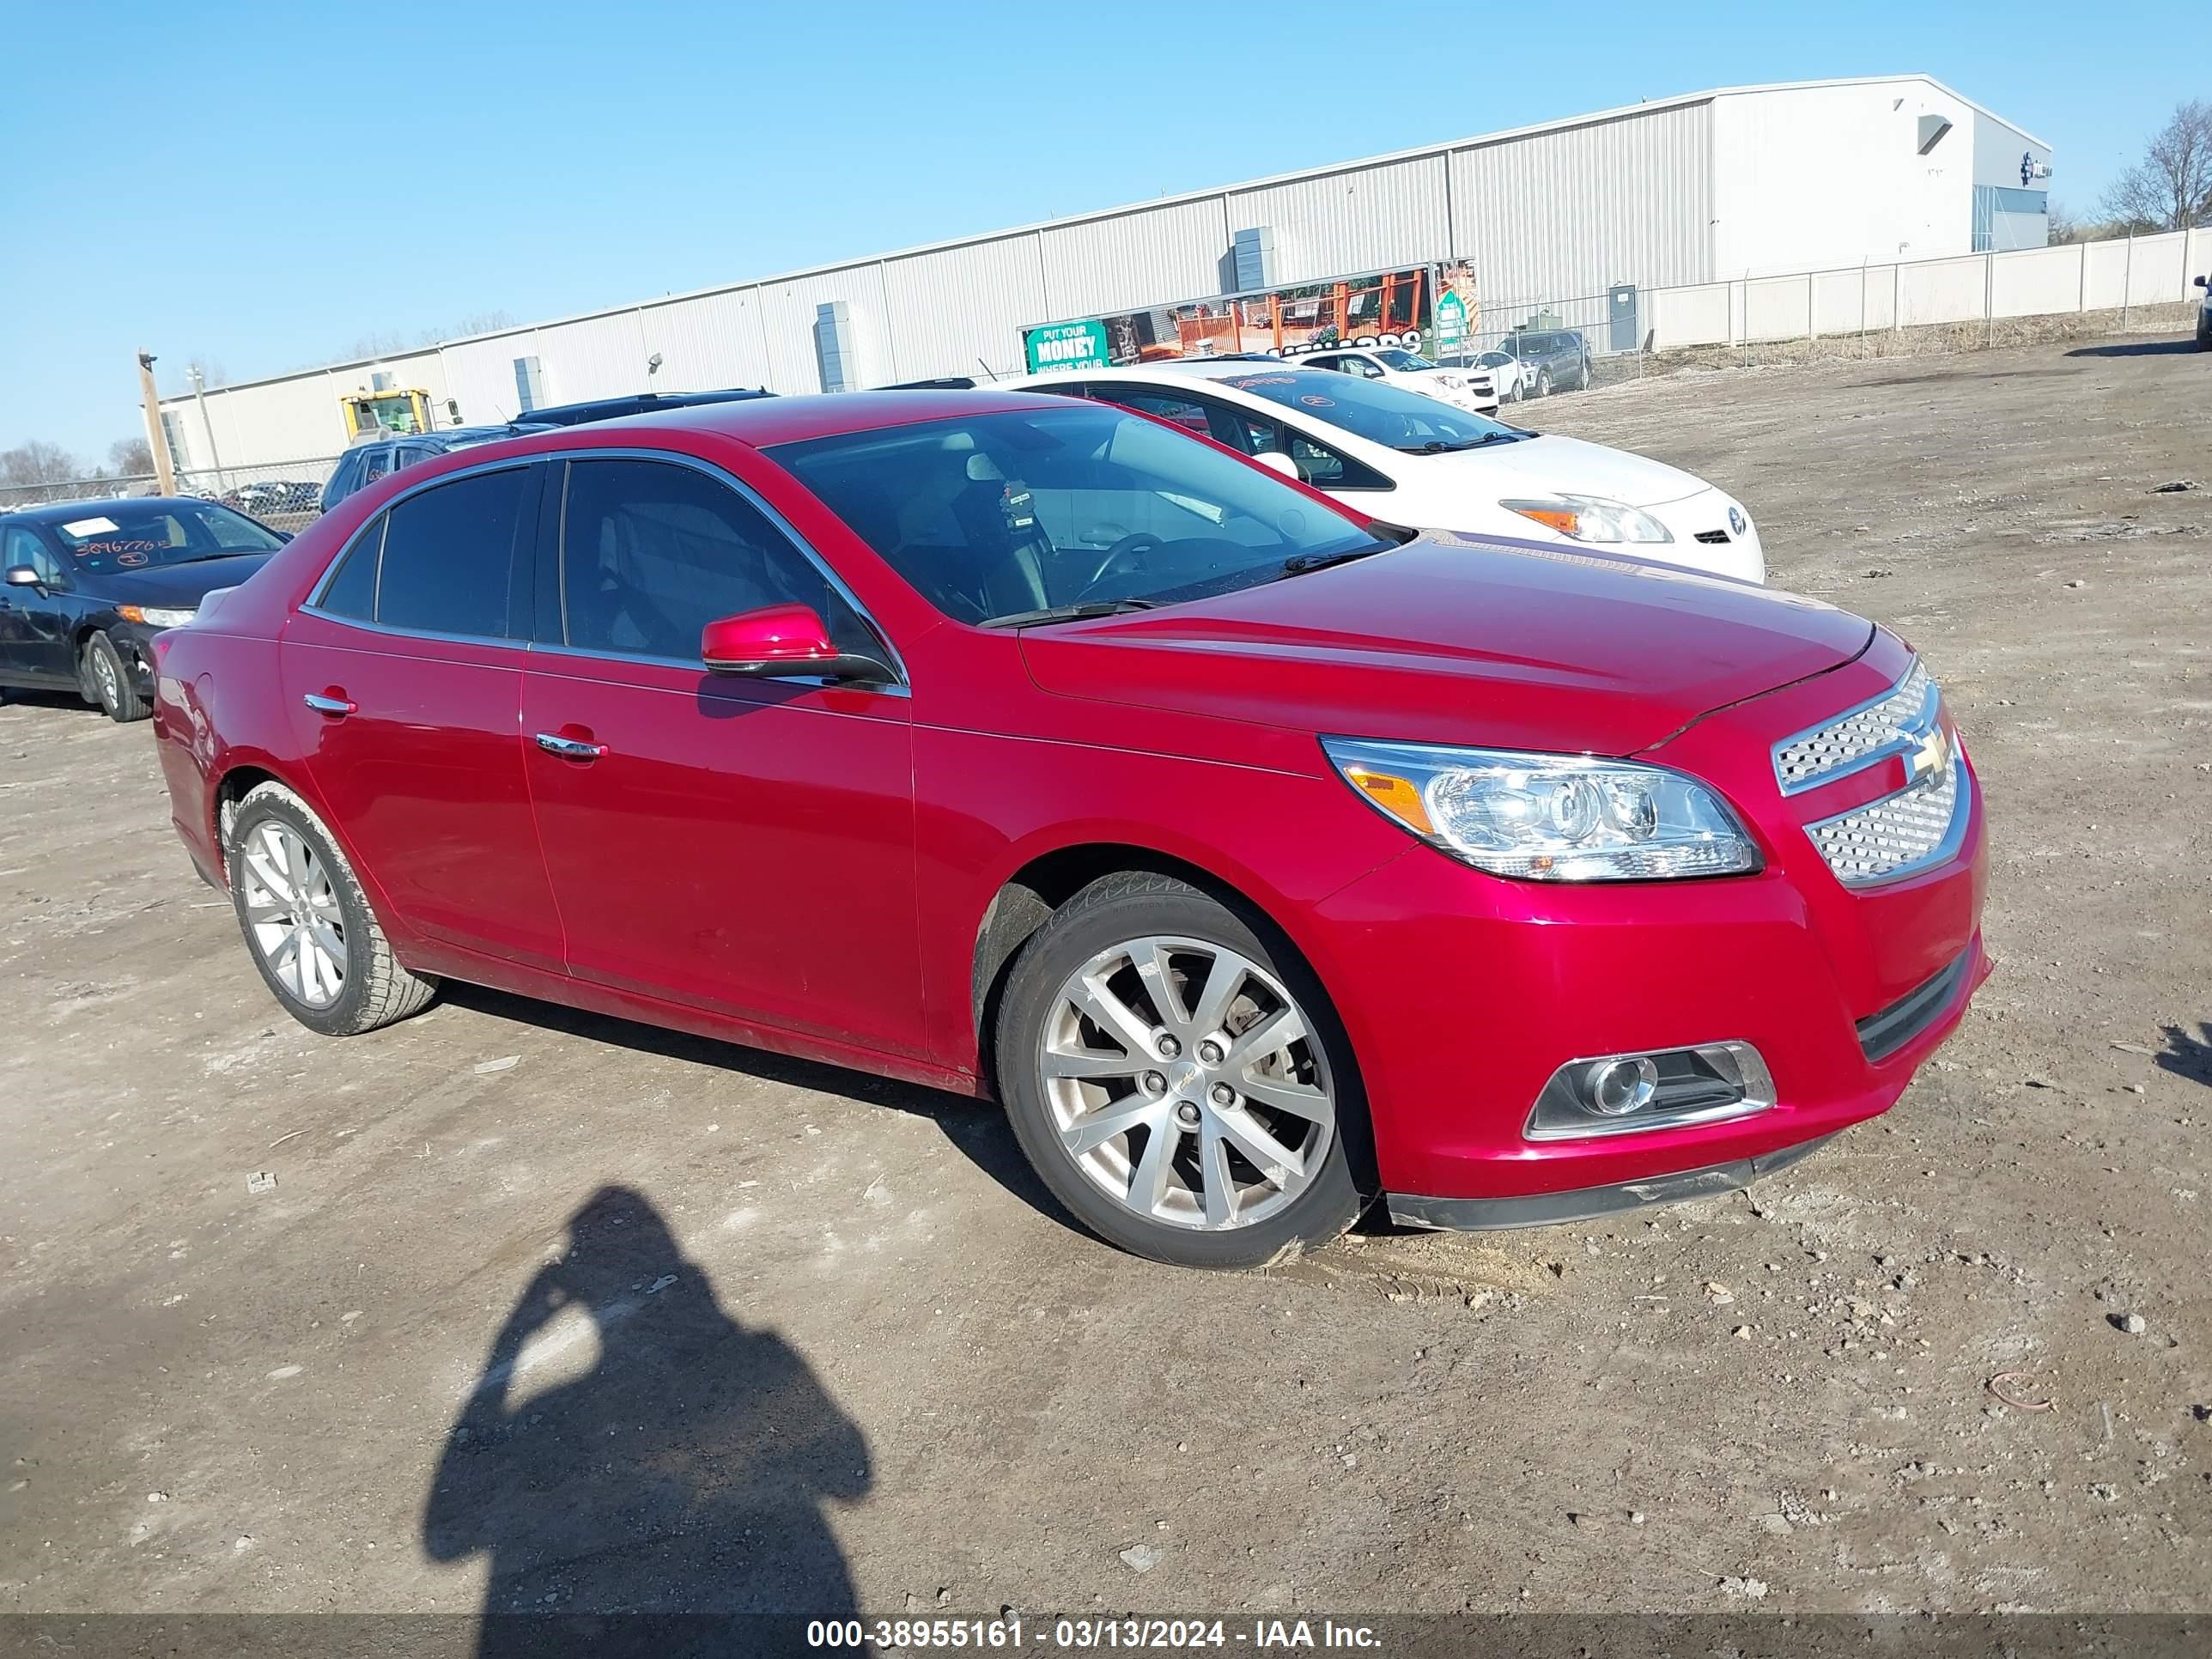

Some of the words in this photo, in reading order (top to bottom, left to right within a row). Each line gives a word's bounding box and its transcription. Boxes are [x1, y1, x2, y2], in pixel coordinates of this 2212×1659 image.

[1042, 329, 1060, 340] PUT
[1060, 325, 1087, 338] YOUR
[1036, 336, 1097, 363] MONEY
[1036, 362, 1073, 374] WHERE
[1075, 359, 1103, 370] YOUR
